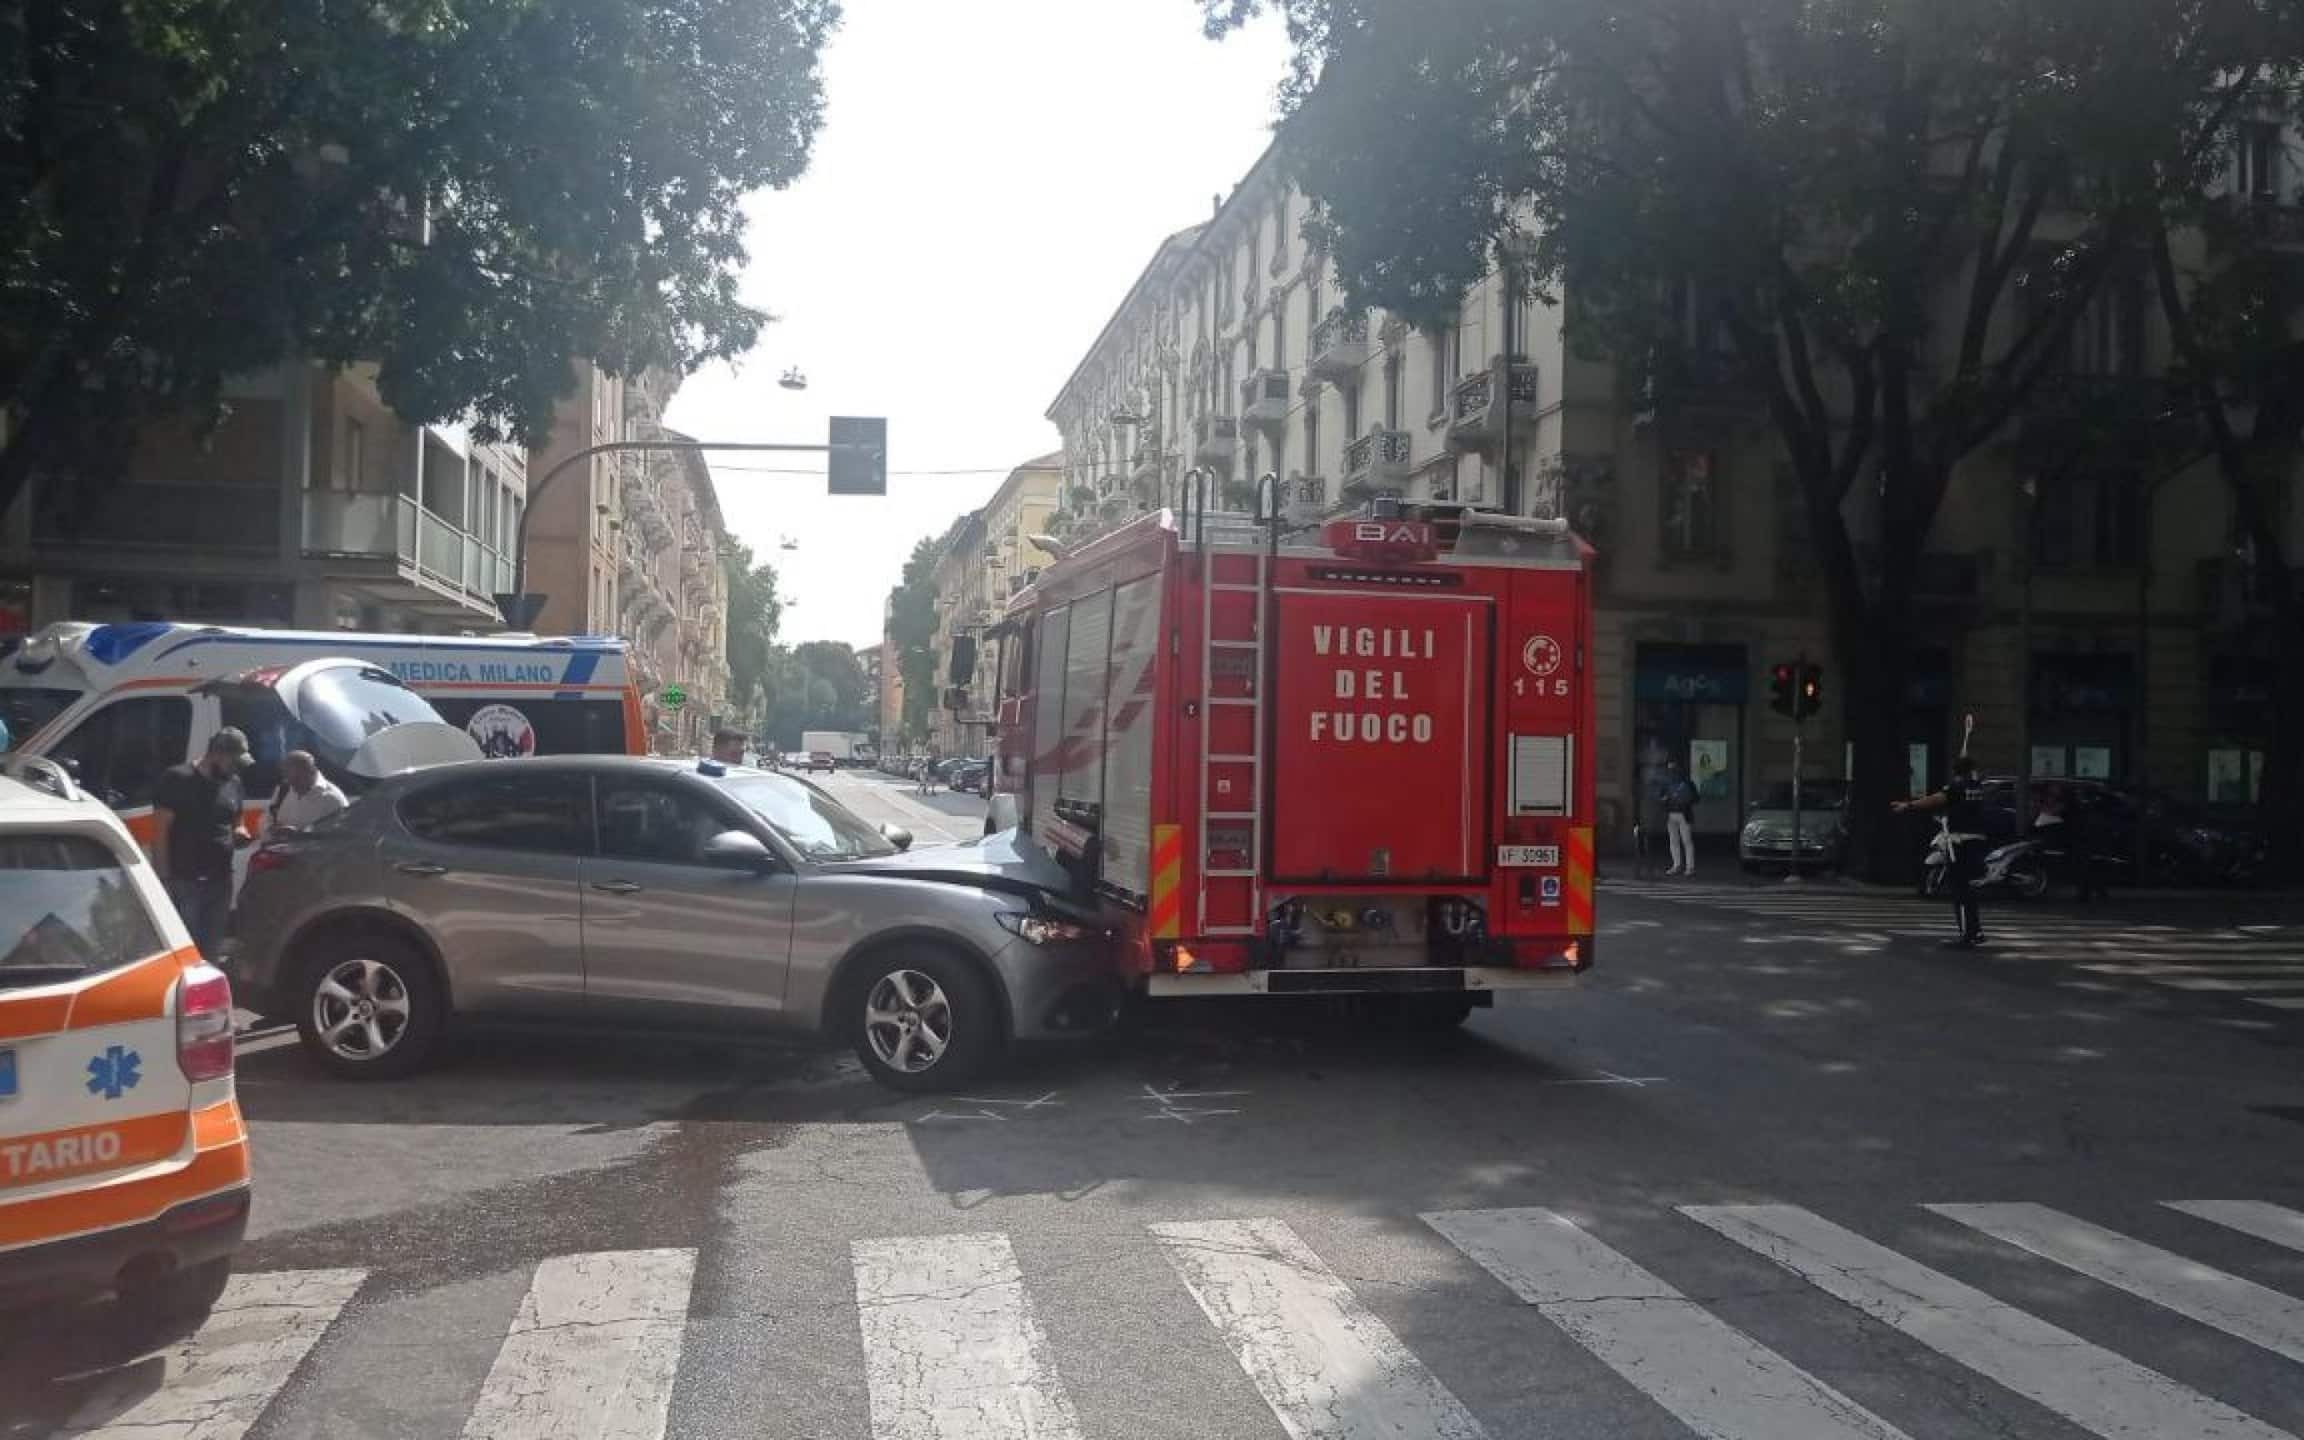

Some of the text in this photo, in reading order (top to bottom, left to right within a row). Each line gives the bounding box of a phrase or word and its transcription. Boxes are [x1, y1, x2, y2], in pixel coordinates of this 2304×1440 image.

[1356, 523, 1429, 544] BAI
[1313, 625, 1434, 659] VIGILI
[391, 661, 552, 683] MEDICA MILANO
[1335, 669, 1410, 700] DEL
[1513, 677, 1568, 697] 115
[1311, 711, 1432, 743] FUOCO
[3, 1131, 121, 1178] TARIO
